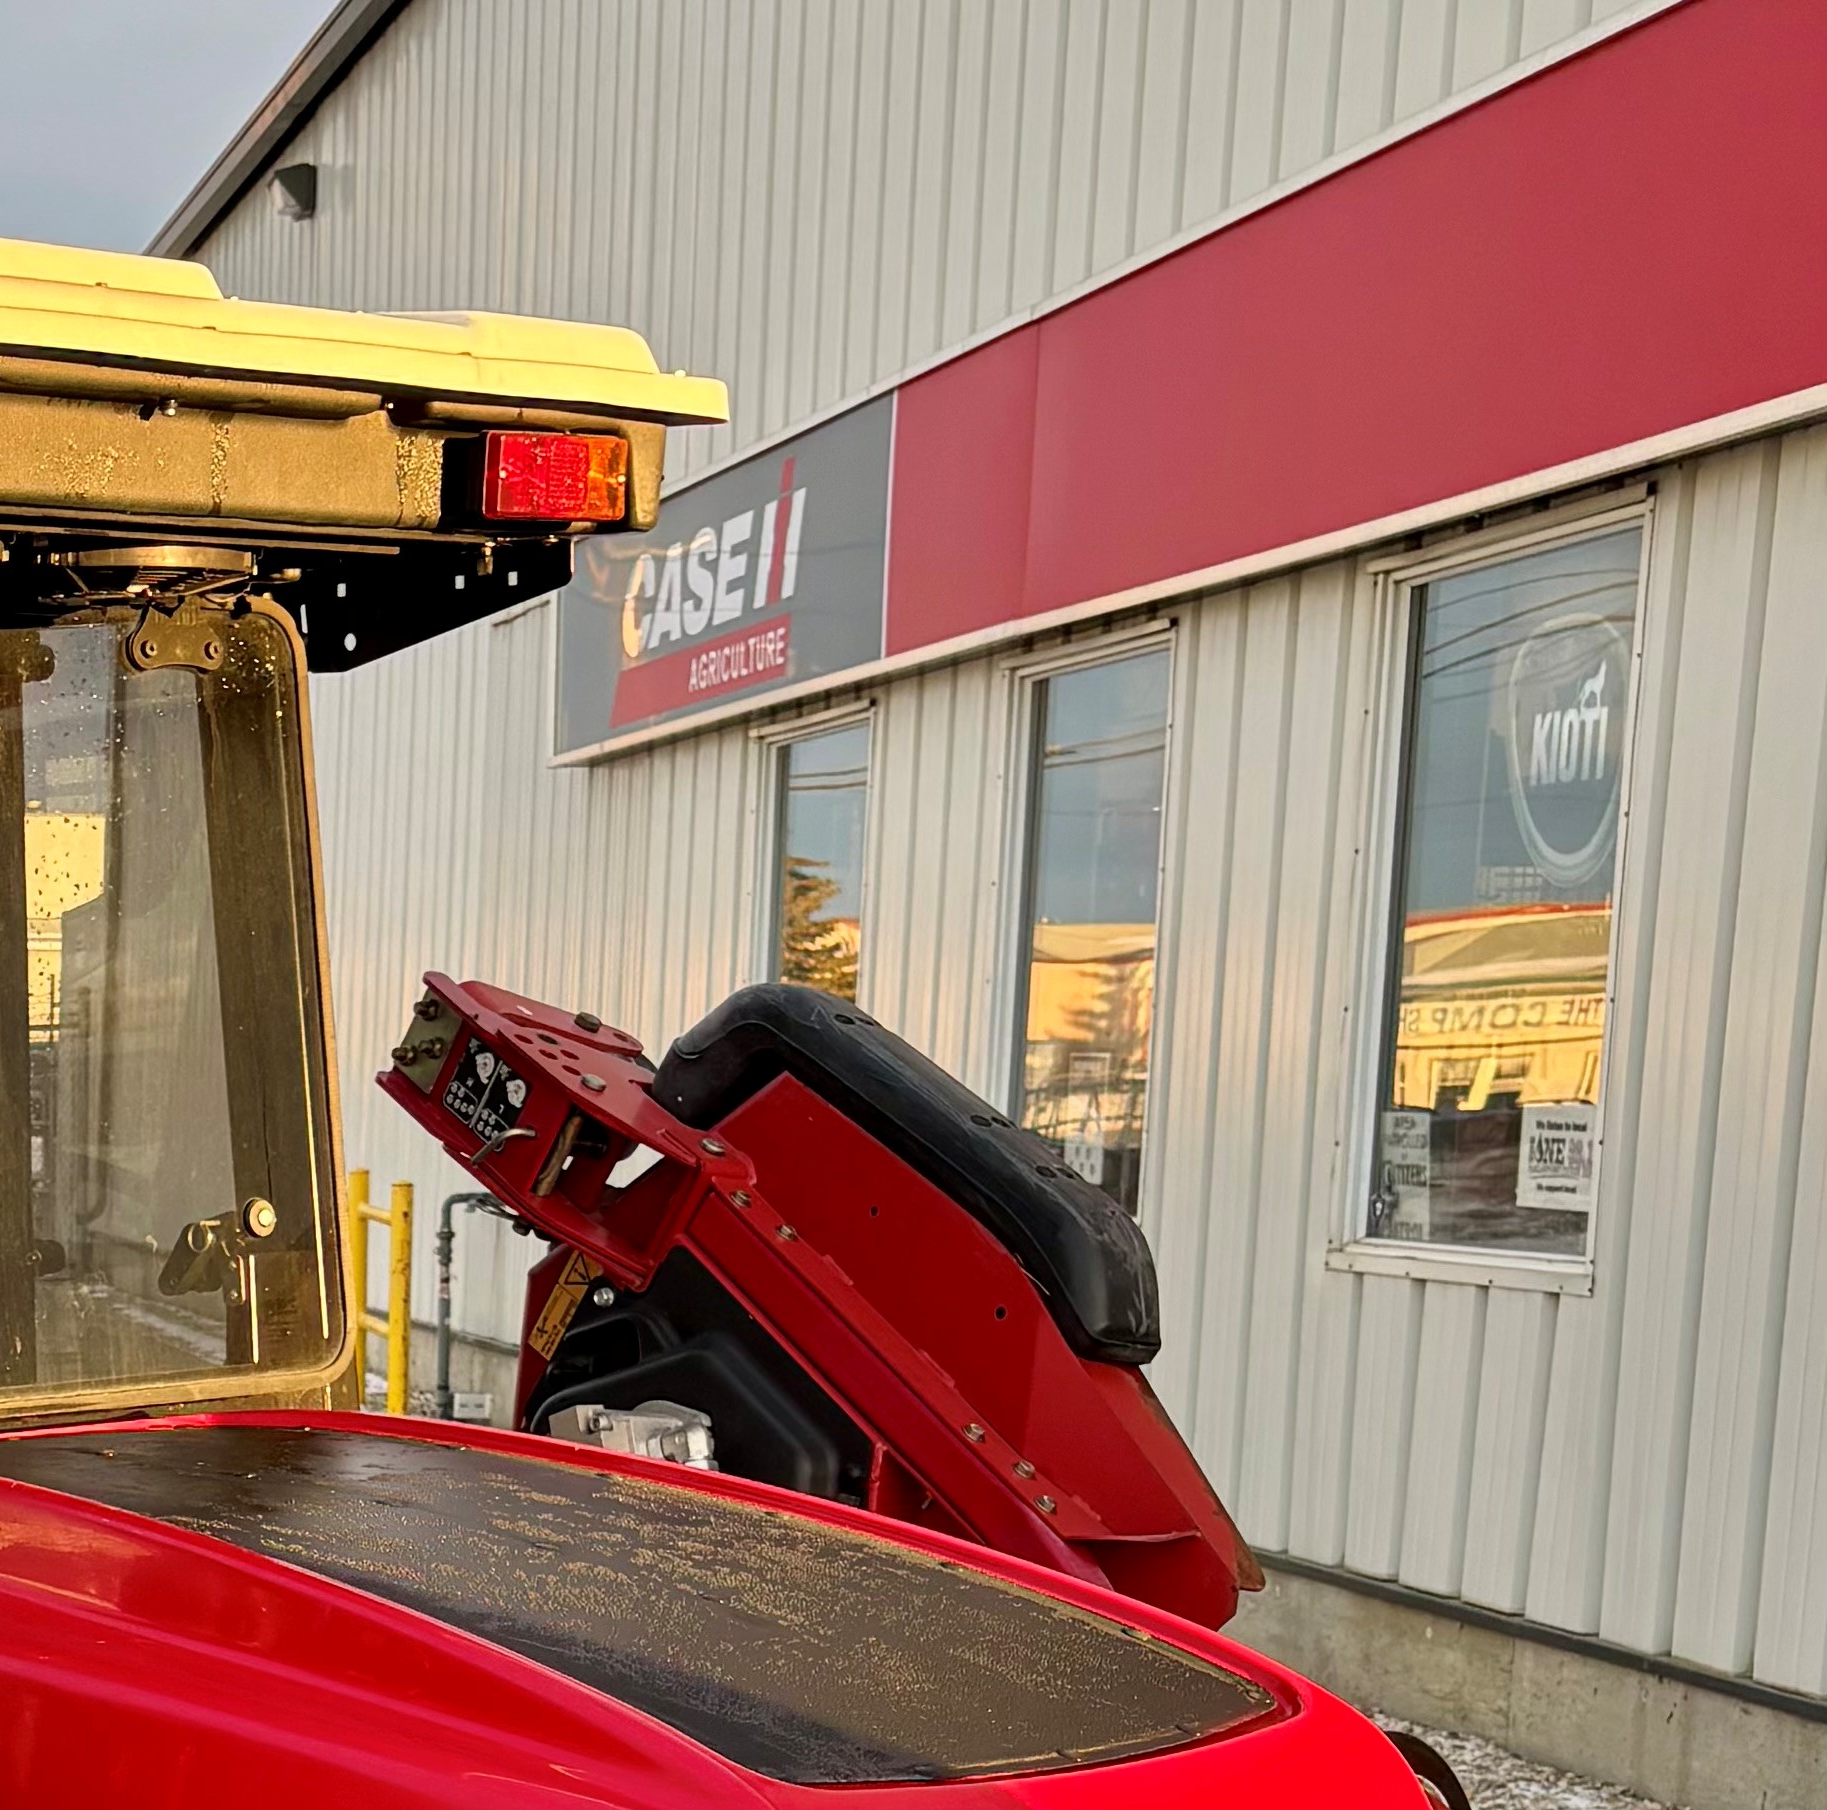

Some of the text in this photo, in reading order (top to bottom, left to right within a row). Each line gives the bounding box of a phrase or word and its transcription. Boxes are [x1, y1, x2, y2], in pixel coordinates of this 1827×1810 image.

[622, 509, 754, 658] CASE
[688, 627, 787, 693] AGRICULTURE
[1529, 704, 1609, 787] KIOTI
